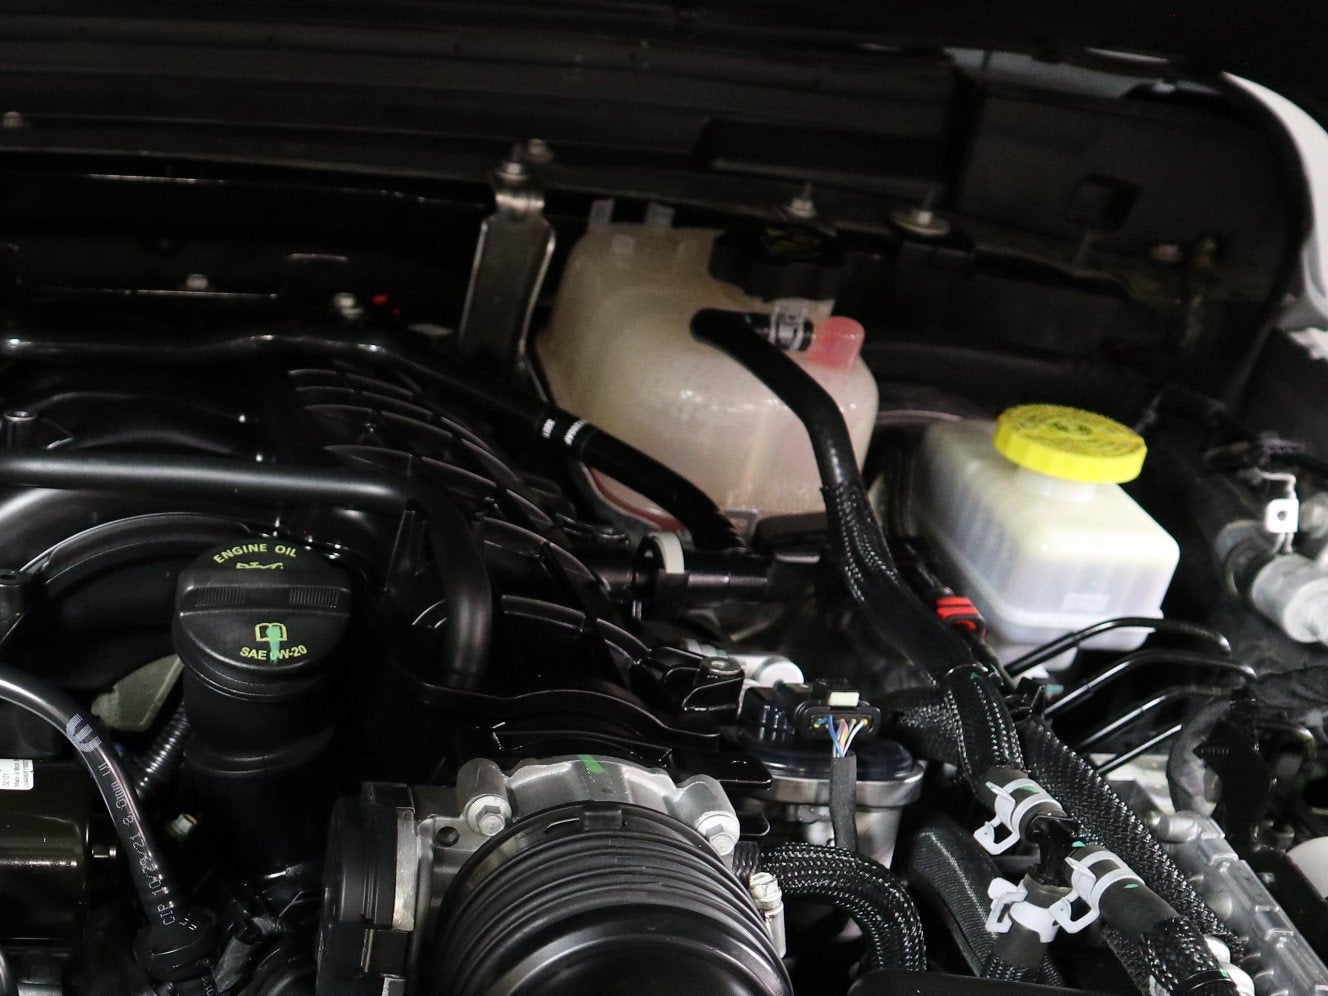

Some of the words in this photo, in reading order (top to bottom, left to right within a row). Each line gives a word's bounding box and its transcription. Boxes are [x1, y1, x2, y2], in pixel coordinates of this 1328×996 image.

[213, 544, 267, 564] ENGINE
[275, 545, 297, 558] OIL
[239, 646, 267, 660] SAE
